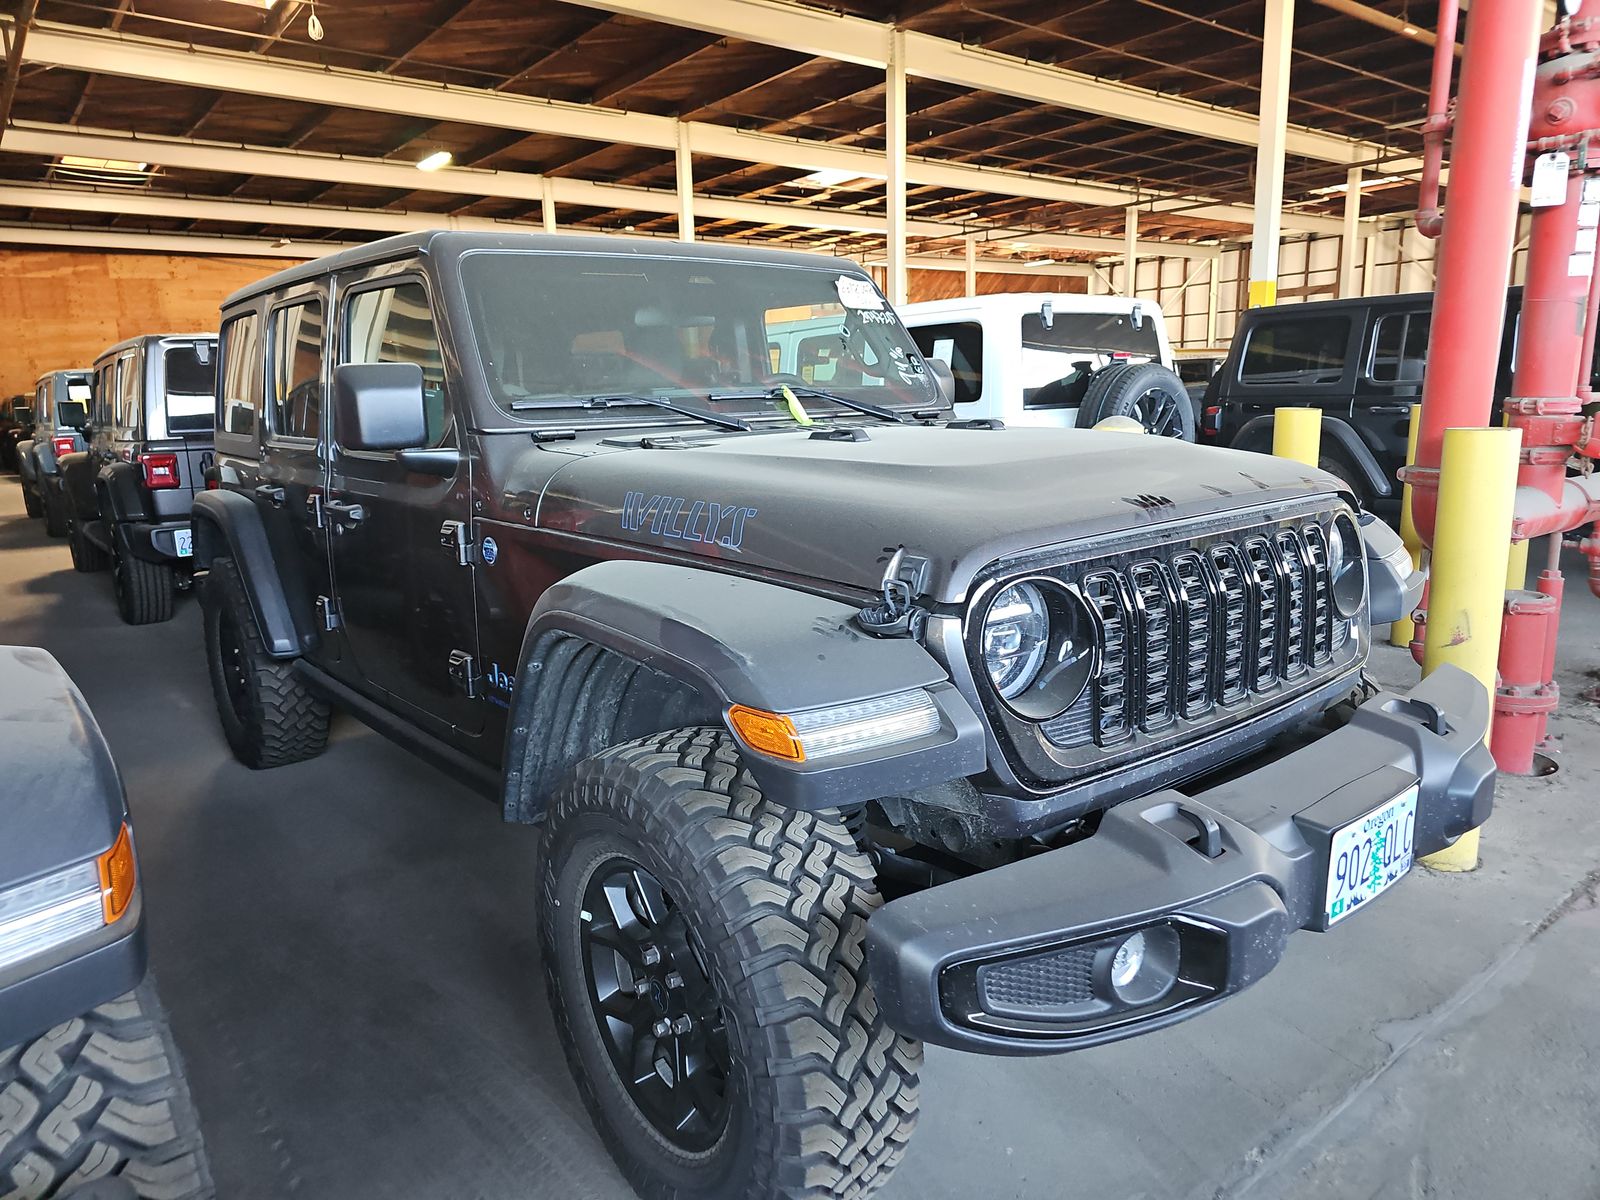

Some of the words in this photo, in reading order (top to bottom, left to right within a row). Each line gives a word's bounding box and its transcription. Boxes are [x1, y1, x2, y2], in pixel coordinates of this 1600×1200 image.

[621, 491, 758, 548] WILLYS
[487, 662, 516, 692] Jee
[1363, 806, 1395, 833] Oregon
[1336, 837, 1372, 899] 902
[1383, 809, 1413, 868] QLC
